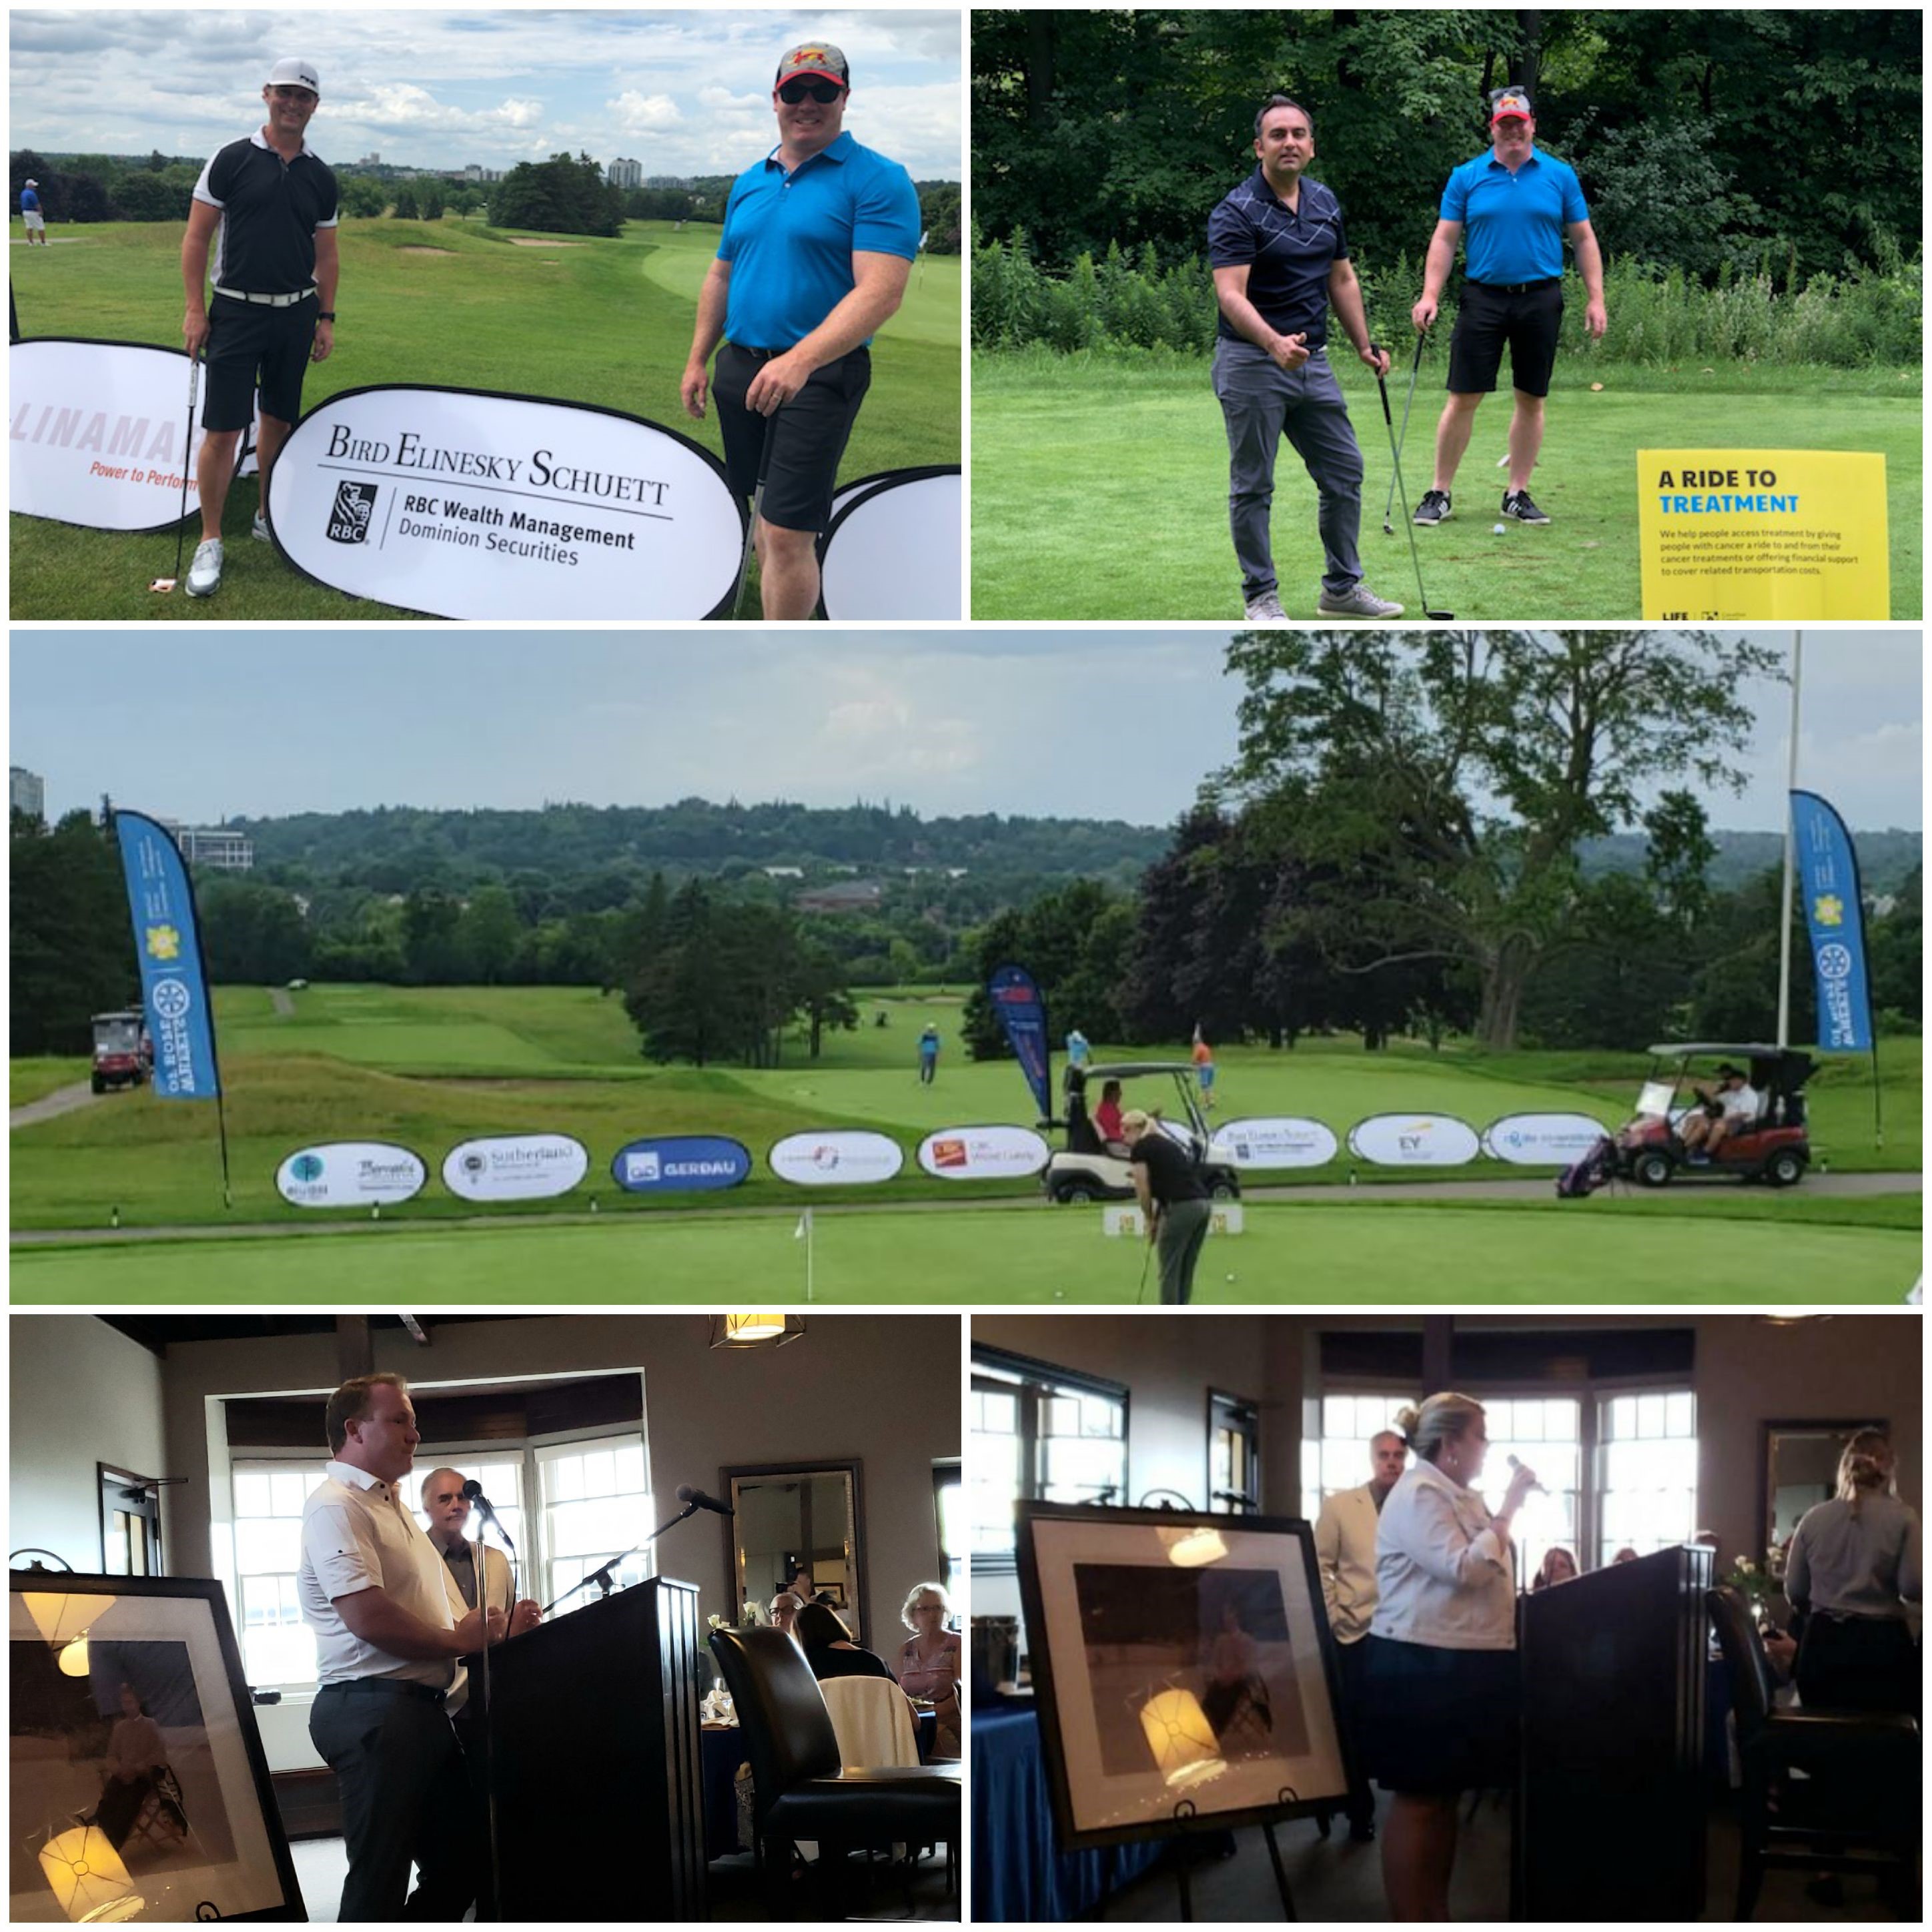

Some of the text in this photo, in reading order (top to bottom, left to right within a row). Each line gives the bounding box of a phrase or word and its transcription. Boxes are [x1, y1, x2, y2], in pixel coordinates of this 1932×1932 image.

[89, 461, 198, 491] Power to Perform
[1658, 470, 1777, 488] A RIDE TO
[1659, 494, 1799, 513] TREATMENT
[404, 495, 634, 550] RBC Wealth Management
[330, 523, 364, 541] RBC
[1660, 530, 1675, 538] We
[1677, 530, 1697, 538] help
[1699, 529, 1729, 538] people
[1806, 530, 1815, 538] by
[1817, 530, 1841, 540] giving
[399, 518, 578, 566] Dominion Securities
[1660, 542, 1690, 552] people
[1692, 542, 1713, 550] with
[1784, 541, 1799, 549] and
[1800, 541, 1821, 550] from
[1822, 542, 1841, 550] their
[1660, 555, 1690, 563] cancer
[1693, 554, 1743, 562] treatments
[1756, 552, 1791, 563] offering
[1792, 553, 1827, 562] financial
[1827, 556, 1859, 564] support
[1661, 568, 1671, 576] to
[1701, 566, 1733, 574] related
[1735, 566, 1797, 576] transportation
[1799, 567, 1821, 575] costs.
[1662, 612, 1688, 620] LIFE
[1398, 1135, 1421, 1149] EY
[664, 1161, 736, 1176] GERDAU
